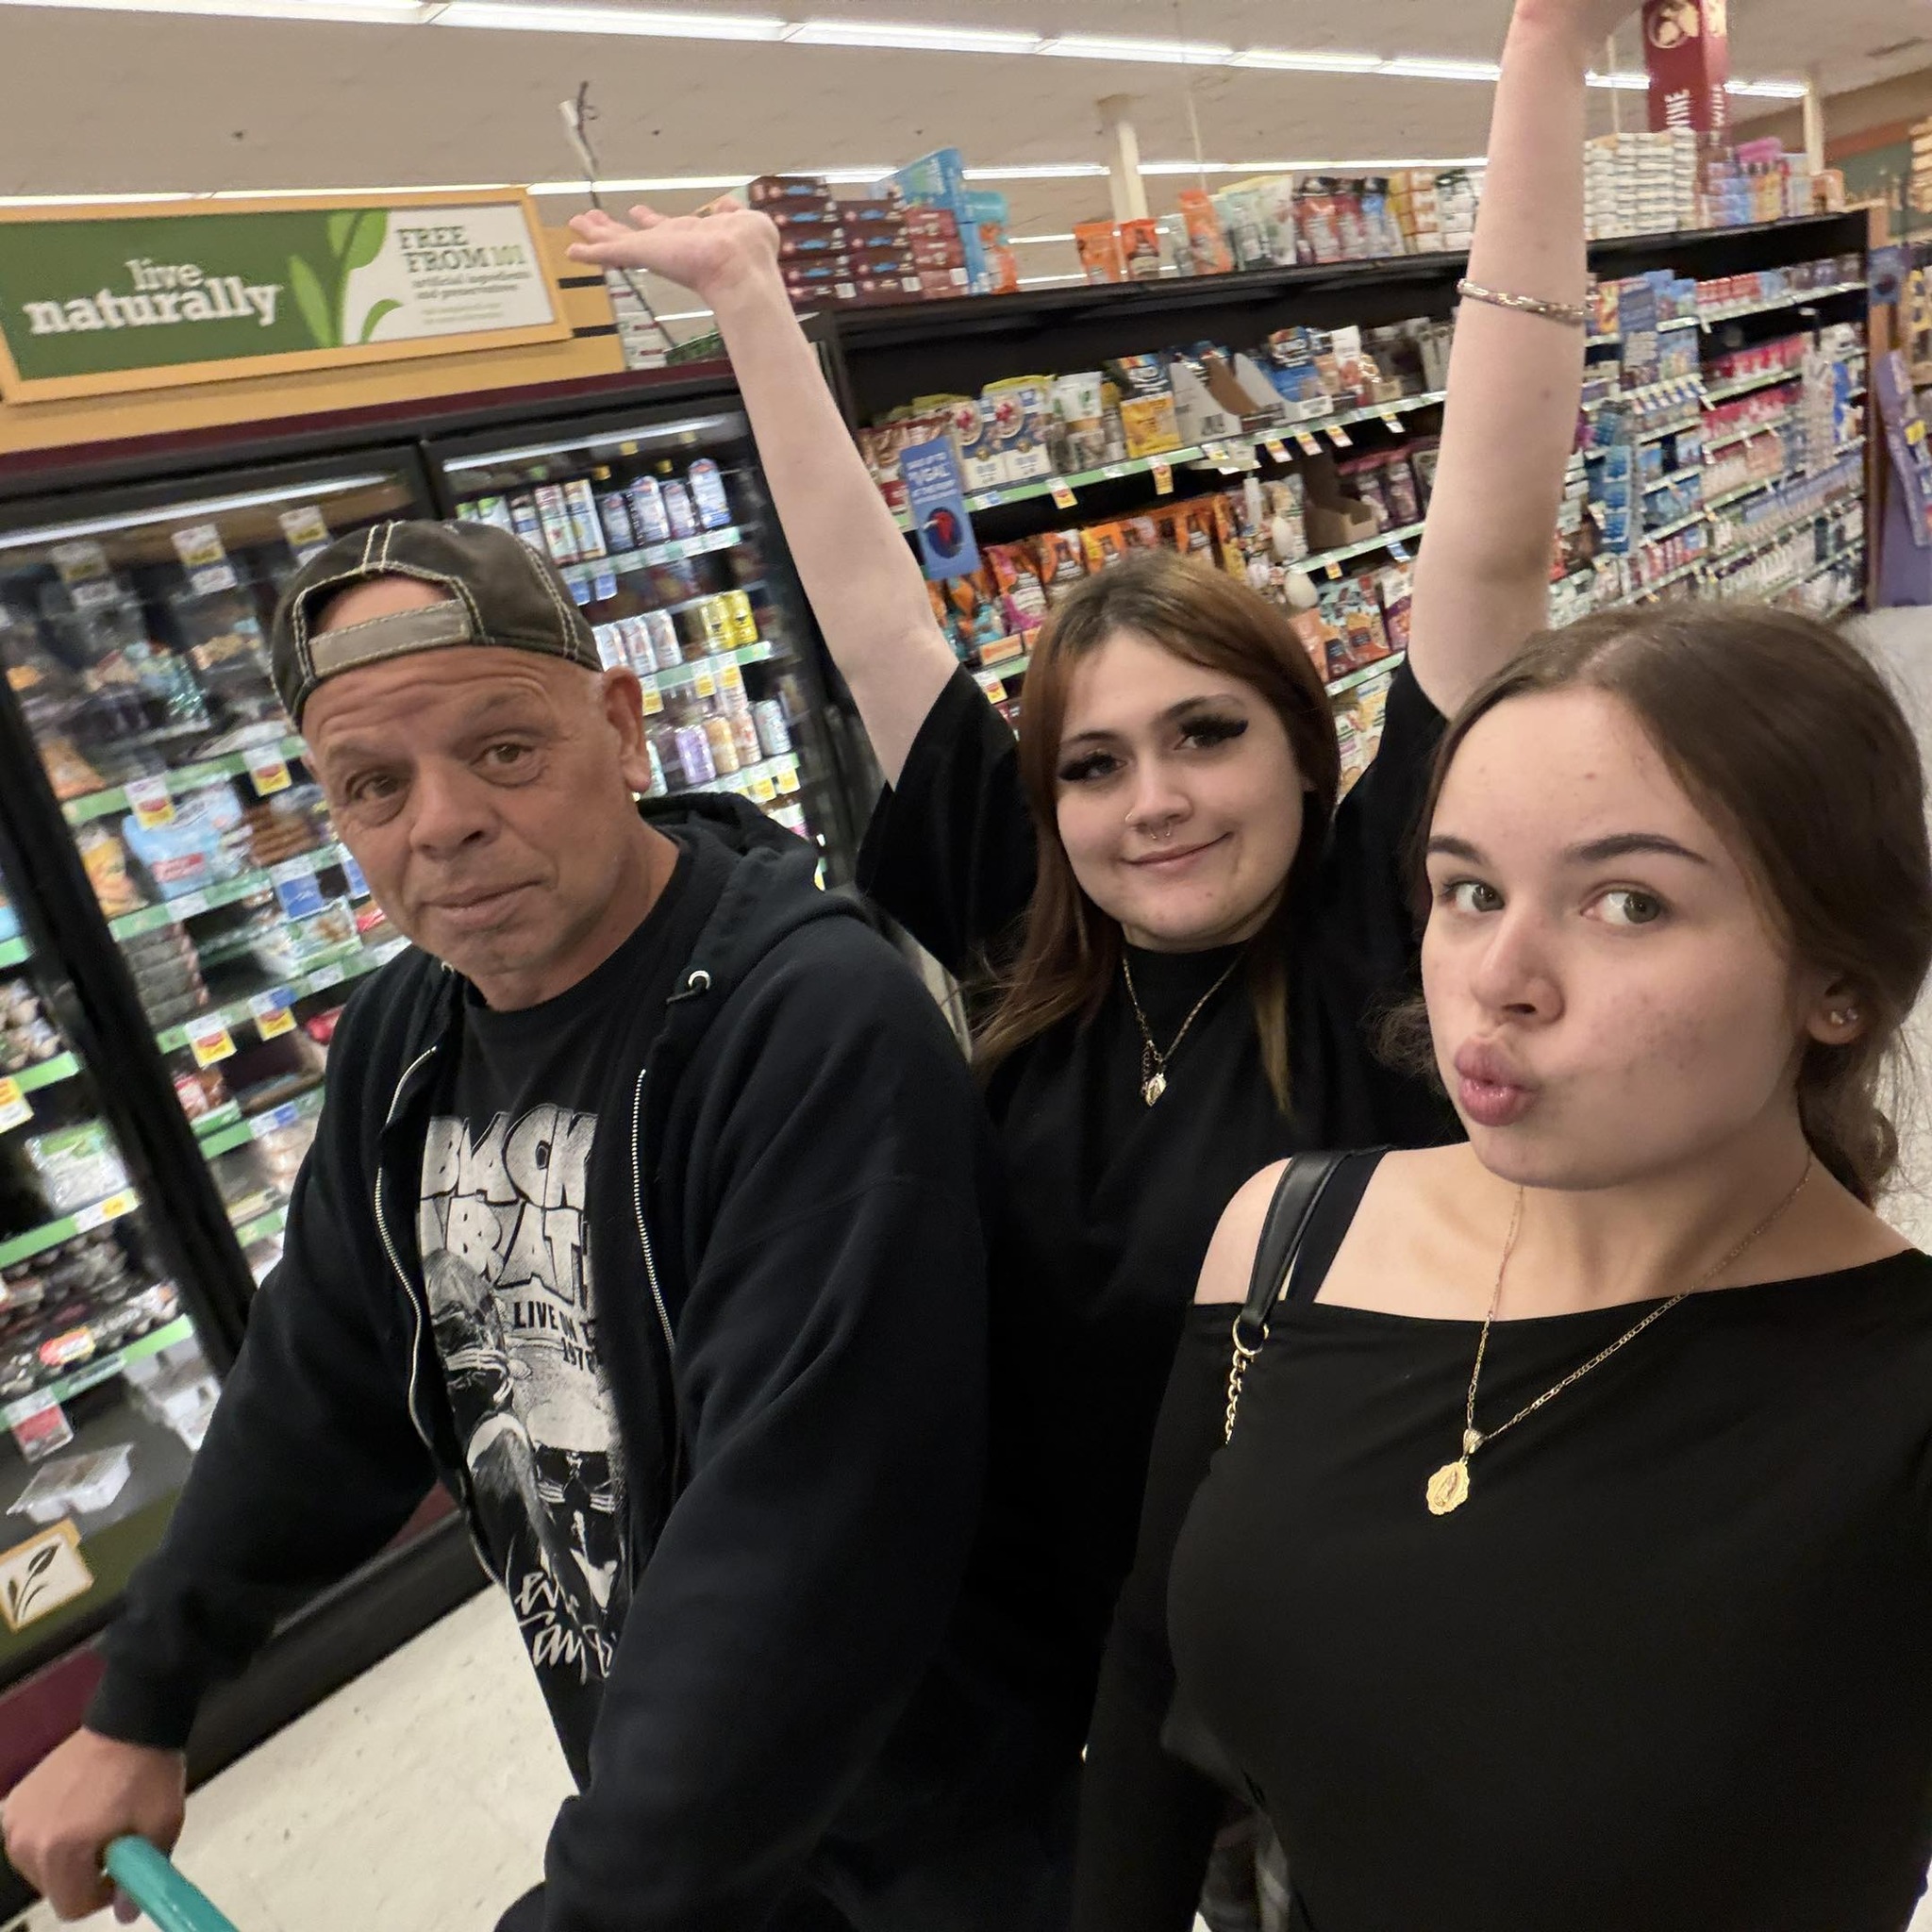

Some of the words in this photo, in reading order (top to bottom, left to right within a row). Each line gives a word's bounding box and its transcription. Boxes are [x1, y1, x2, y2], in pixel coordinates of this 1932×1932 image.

[1664, 89, 1690, 125] INE
[395, 226, 468, 249] FREE
[124, 258, 205, 291] live
[402, 247, 489, 273] FROM
[22, 275, 285, 335] naturally
[421, 1103, 600, 1210] BLACK
[514, 1300, 559, 1331] LIVE
